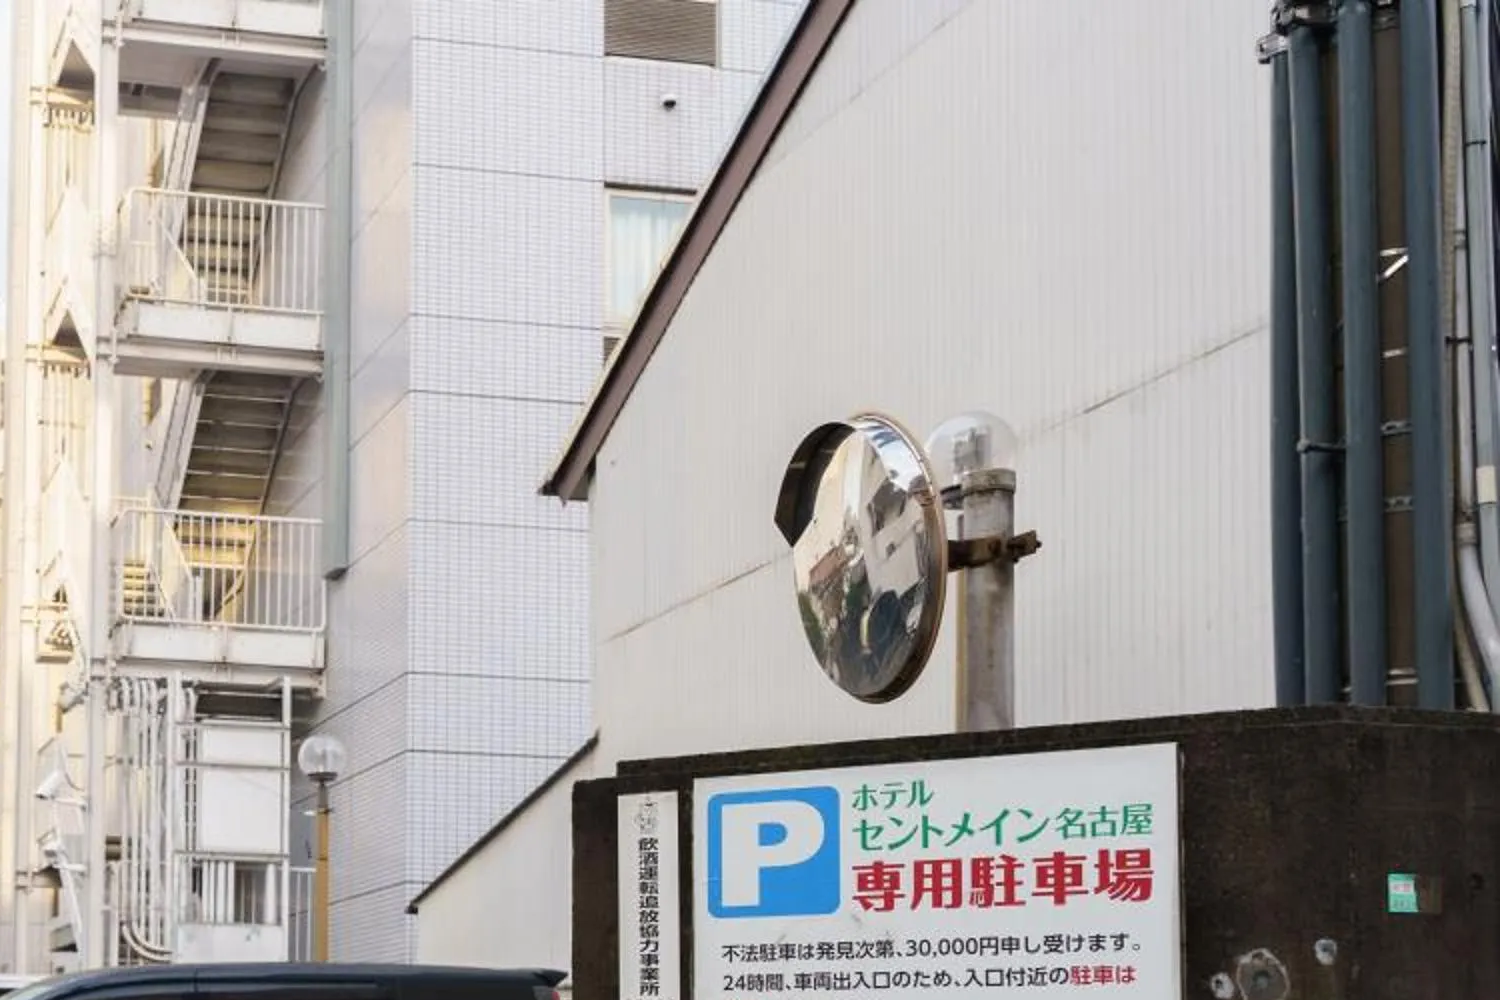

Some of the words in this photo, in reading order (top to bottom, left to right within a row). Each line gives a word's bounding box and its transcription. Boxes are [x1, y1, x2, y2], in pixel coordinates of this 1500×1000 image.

[851, 779, 934, 812] ホテル
[721, 800, 826, 908] P
[851, 803, 1154, 852] セントメイン名古屋
[851, 847, 1155, 913] 専用駐車場
